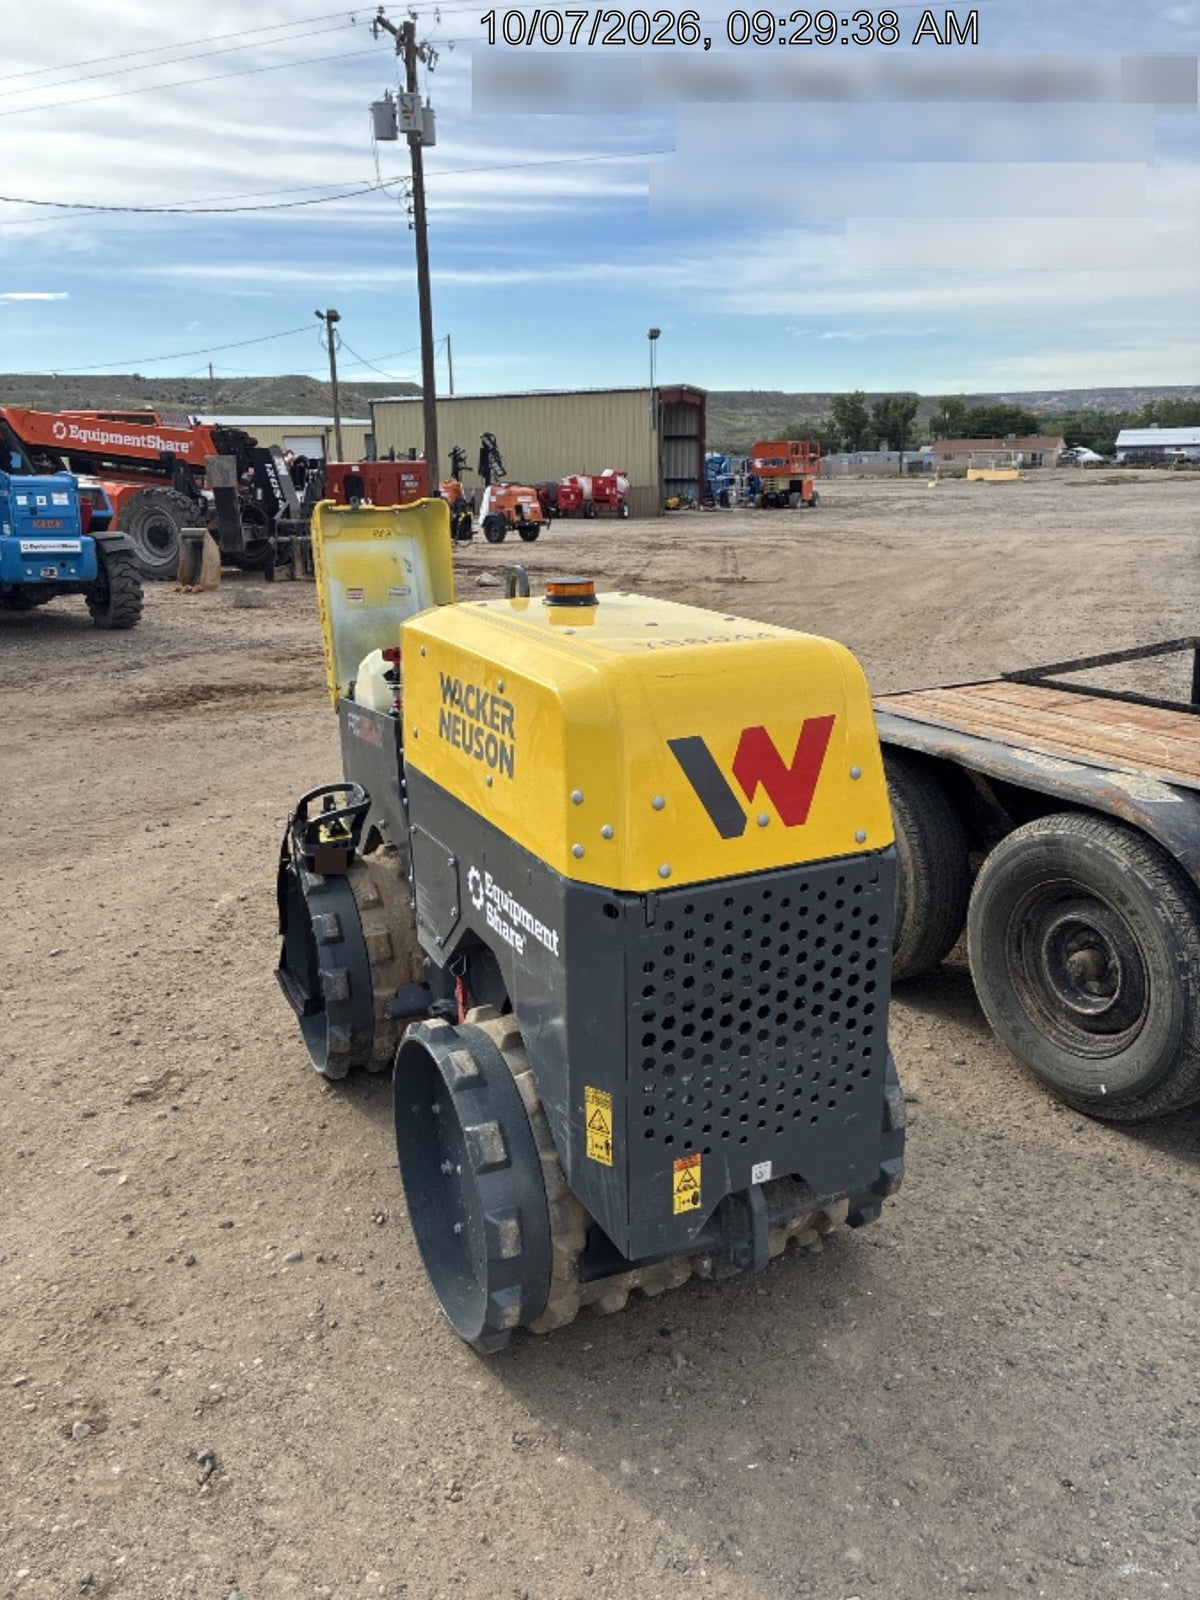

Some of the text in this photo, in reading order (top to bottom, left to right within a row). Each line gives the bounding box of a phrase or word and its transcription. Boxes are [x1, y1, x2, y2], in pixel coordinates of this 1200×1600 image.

[68, 424, 189, 454] EquipmentShare
[438, 671, 516, 740] WACKER
[438, 707, 515, 780] NEUSON
[484, 871, 559, 958] Equipment
[486, 901, 525, 955] Share
